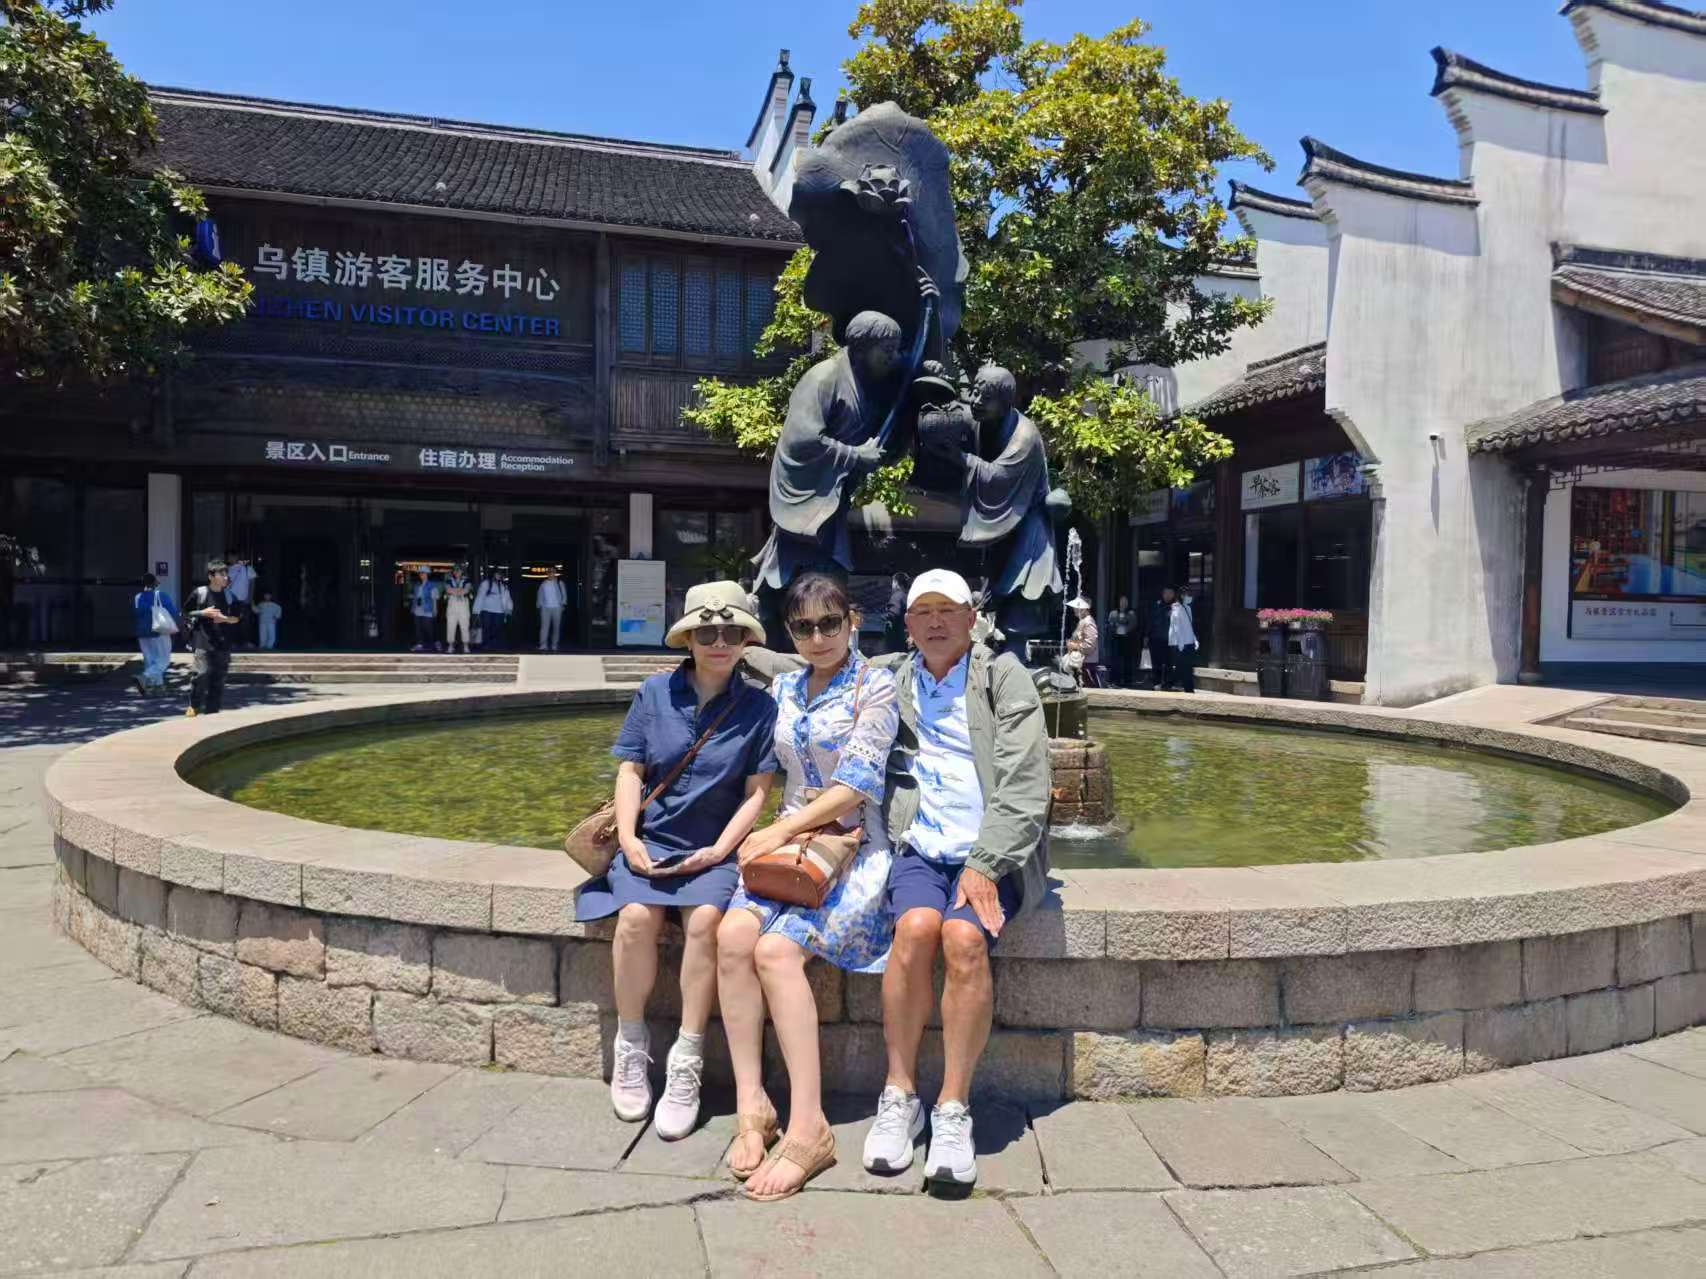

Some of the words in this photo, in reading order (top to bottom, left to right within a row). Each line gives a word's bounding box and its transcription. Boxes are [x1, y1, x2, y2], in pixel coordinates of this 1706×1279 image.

[253, 242, 561, 302] 乌镇游客服务中心
[350, 302, 456, 329] VISITOR
[462, 311, 561, 338] CENTER
[264, 440, 349, 463] 景区入口
[348, 450, 391, 462] Entrance
[418, 447, 497, 471] 住宿办理
[500, 453, 574, 466] Accommodation
[500, 461, 546, 472] Reception
